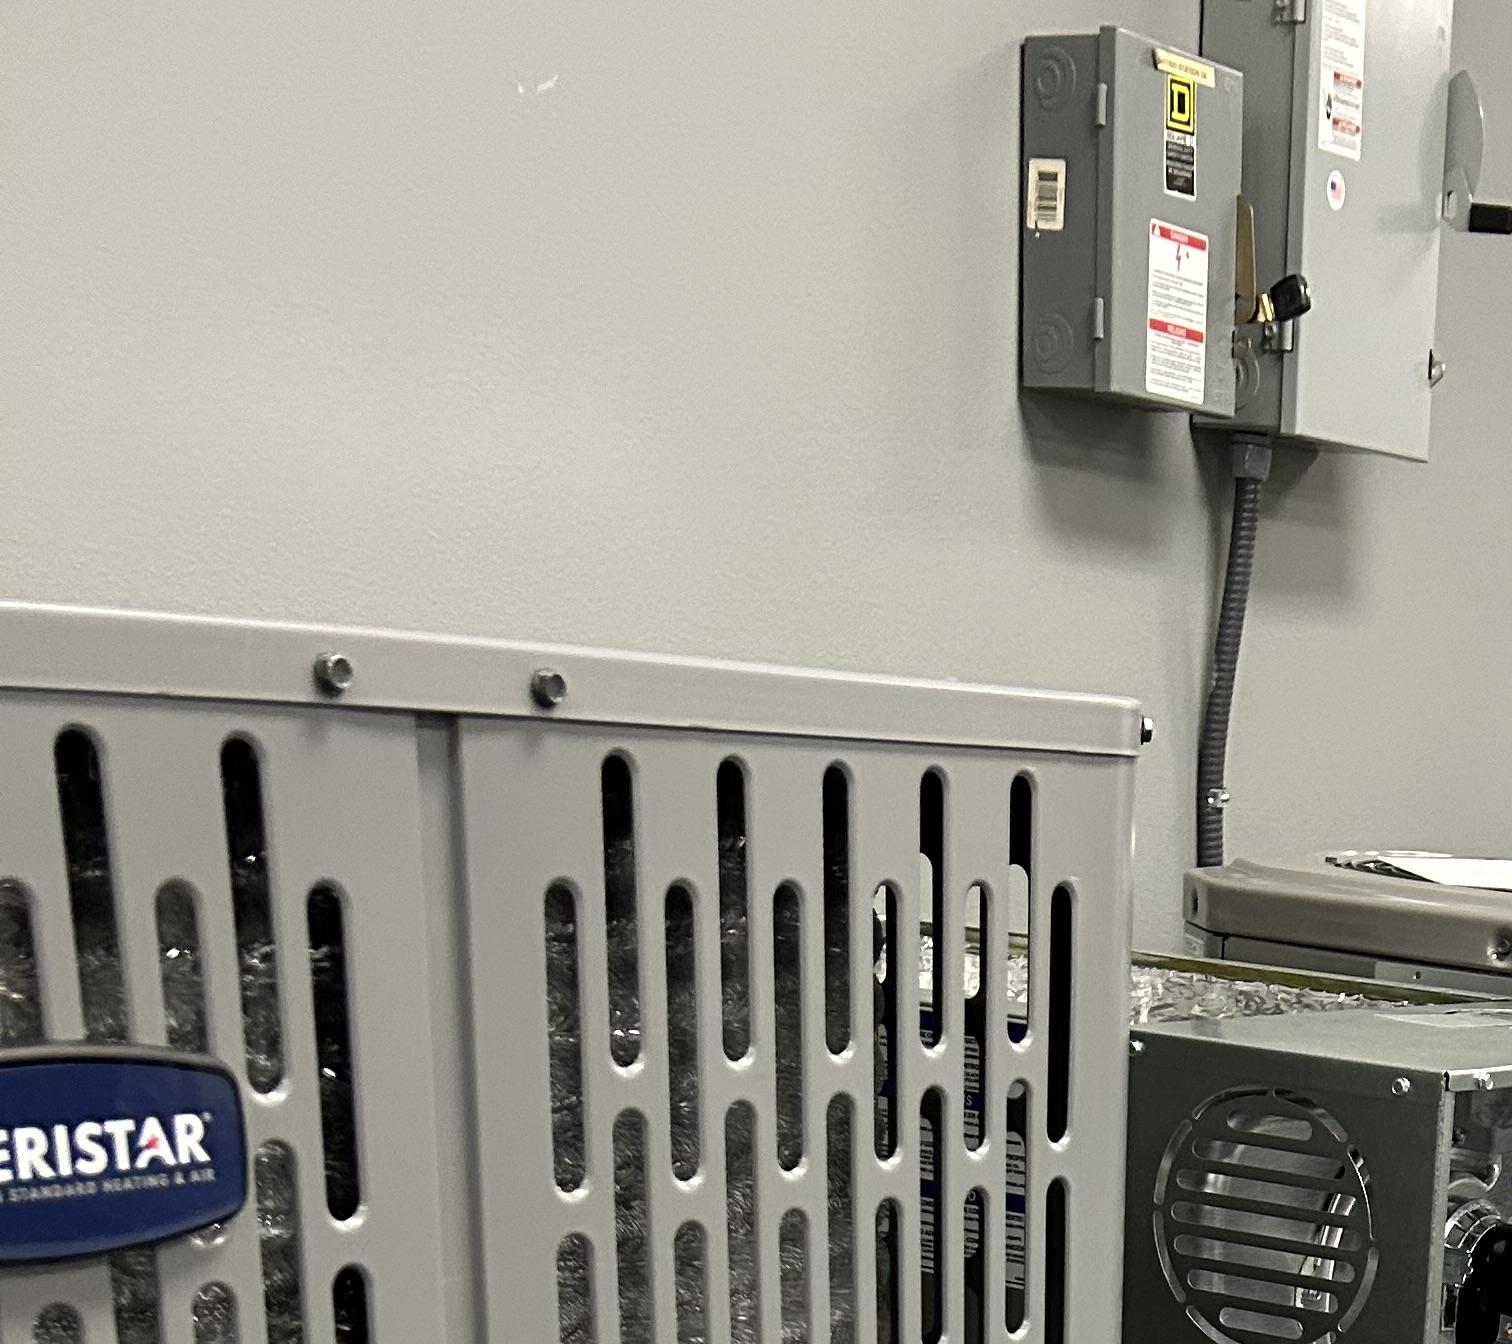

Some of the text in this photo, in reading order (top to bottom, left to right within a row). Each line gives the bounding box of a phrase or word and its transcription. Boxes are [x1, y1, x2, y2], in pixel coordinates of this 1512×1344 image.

[8, 1168, 216, 1202] STANDARD HEATING & AIR
